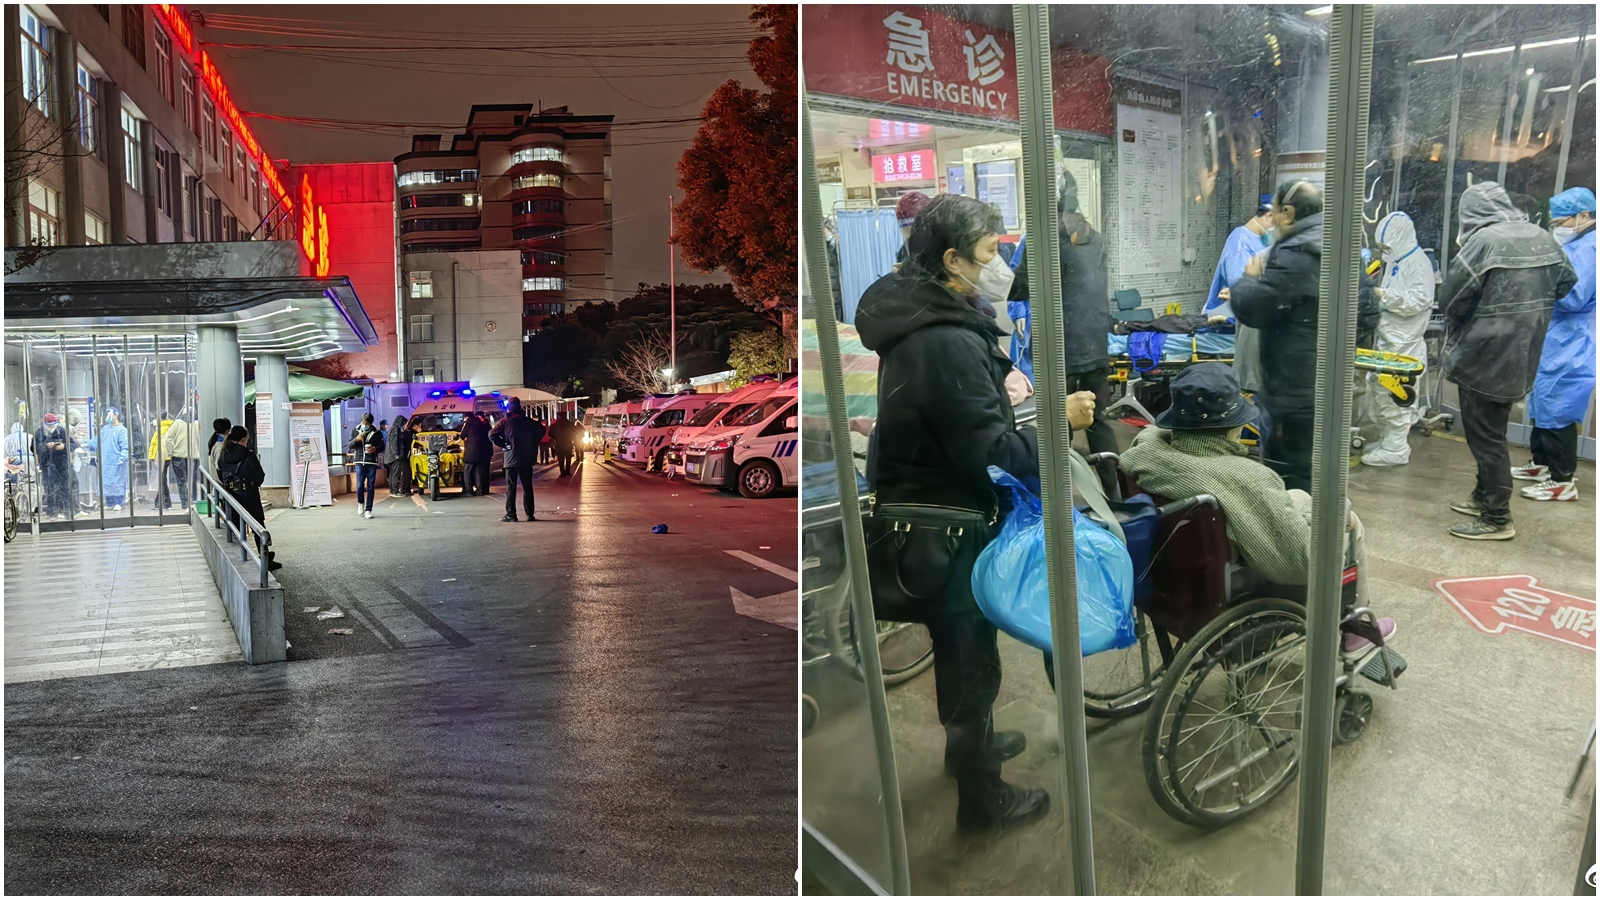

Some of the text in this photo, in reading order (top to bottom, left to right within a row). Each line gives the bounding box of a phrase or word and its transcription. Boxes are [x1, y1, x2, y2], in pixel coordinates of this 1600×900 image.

[882, 10, 1005, 86] 急诊
[887, 72, 1008, 110] EMERGENCY
[883, 153, 922, 175] 抢救室
[1491, 588, 1551, 621] 120
